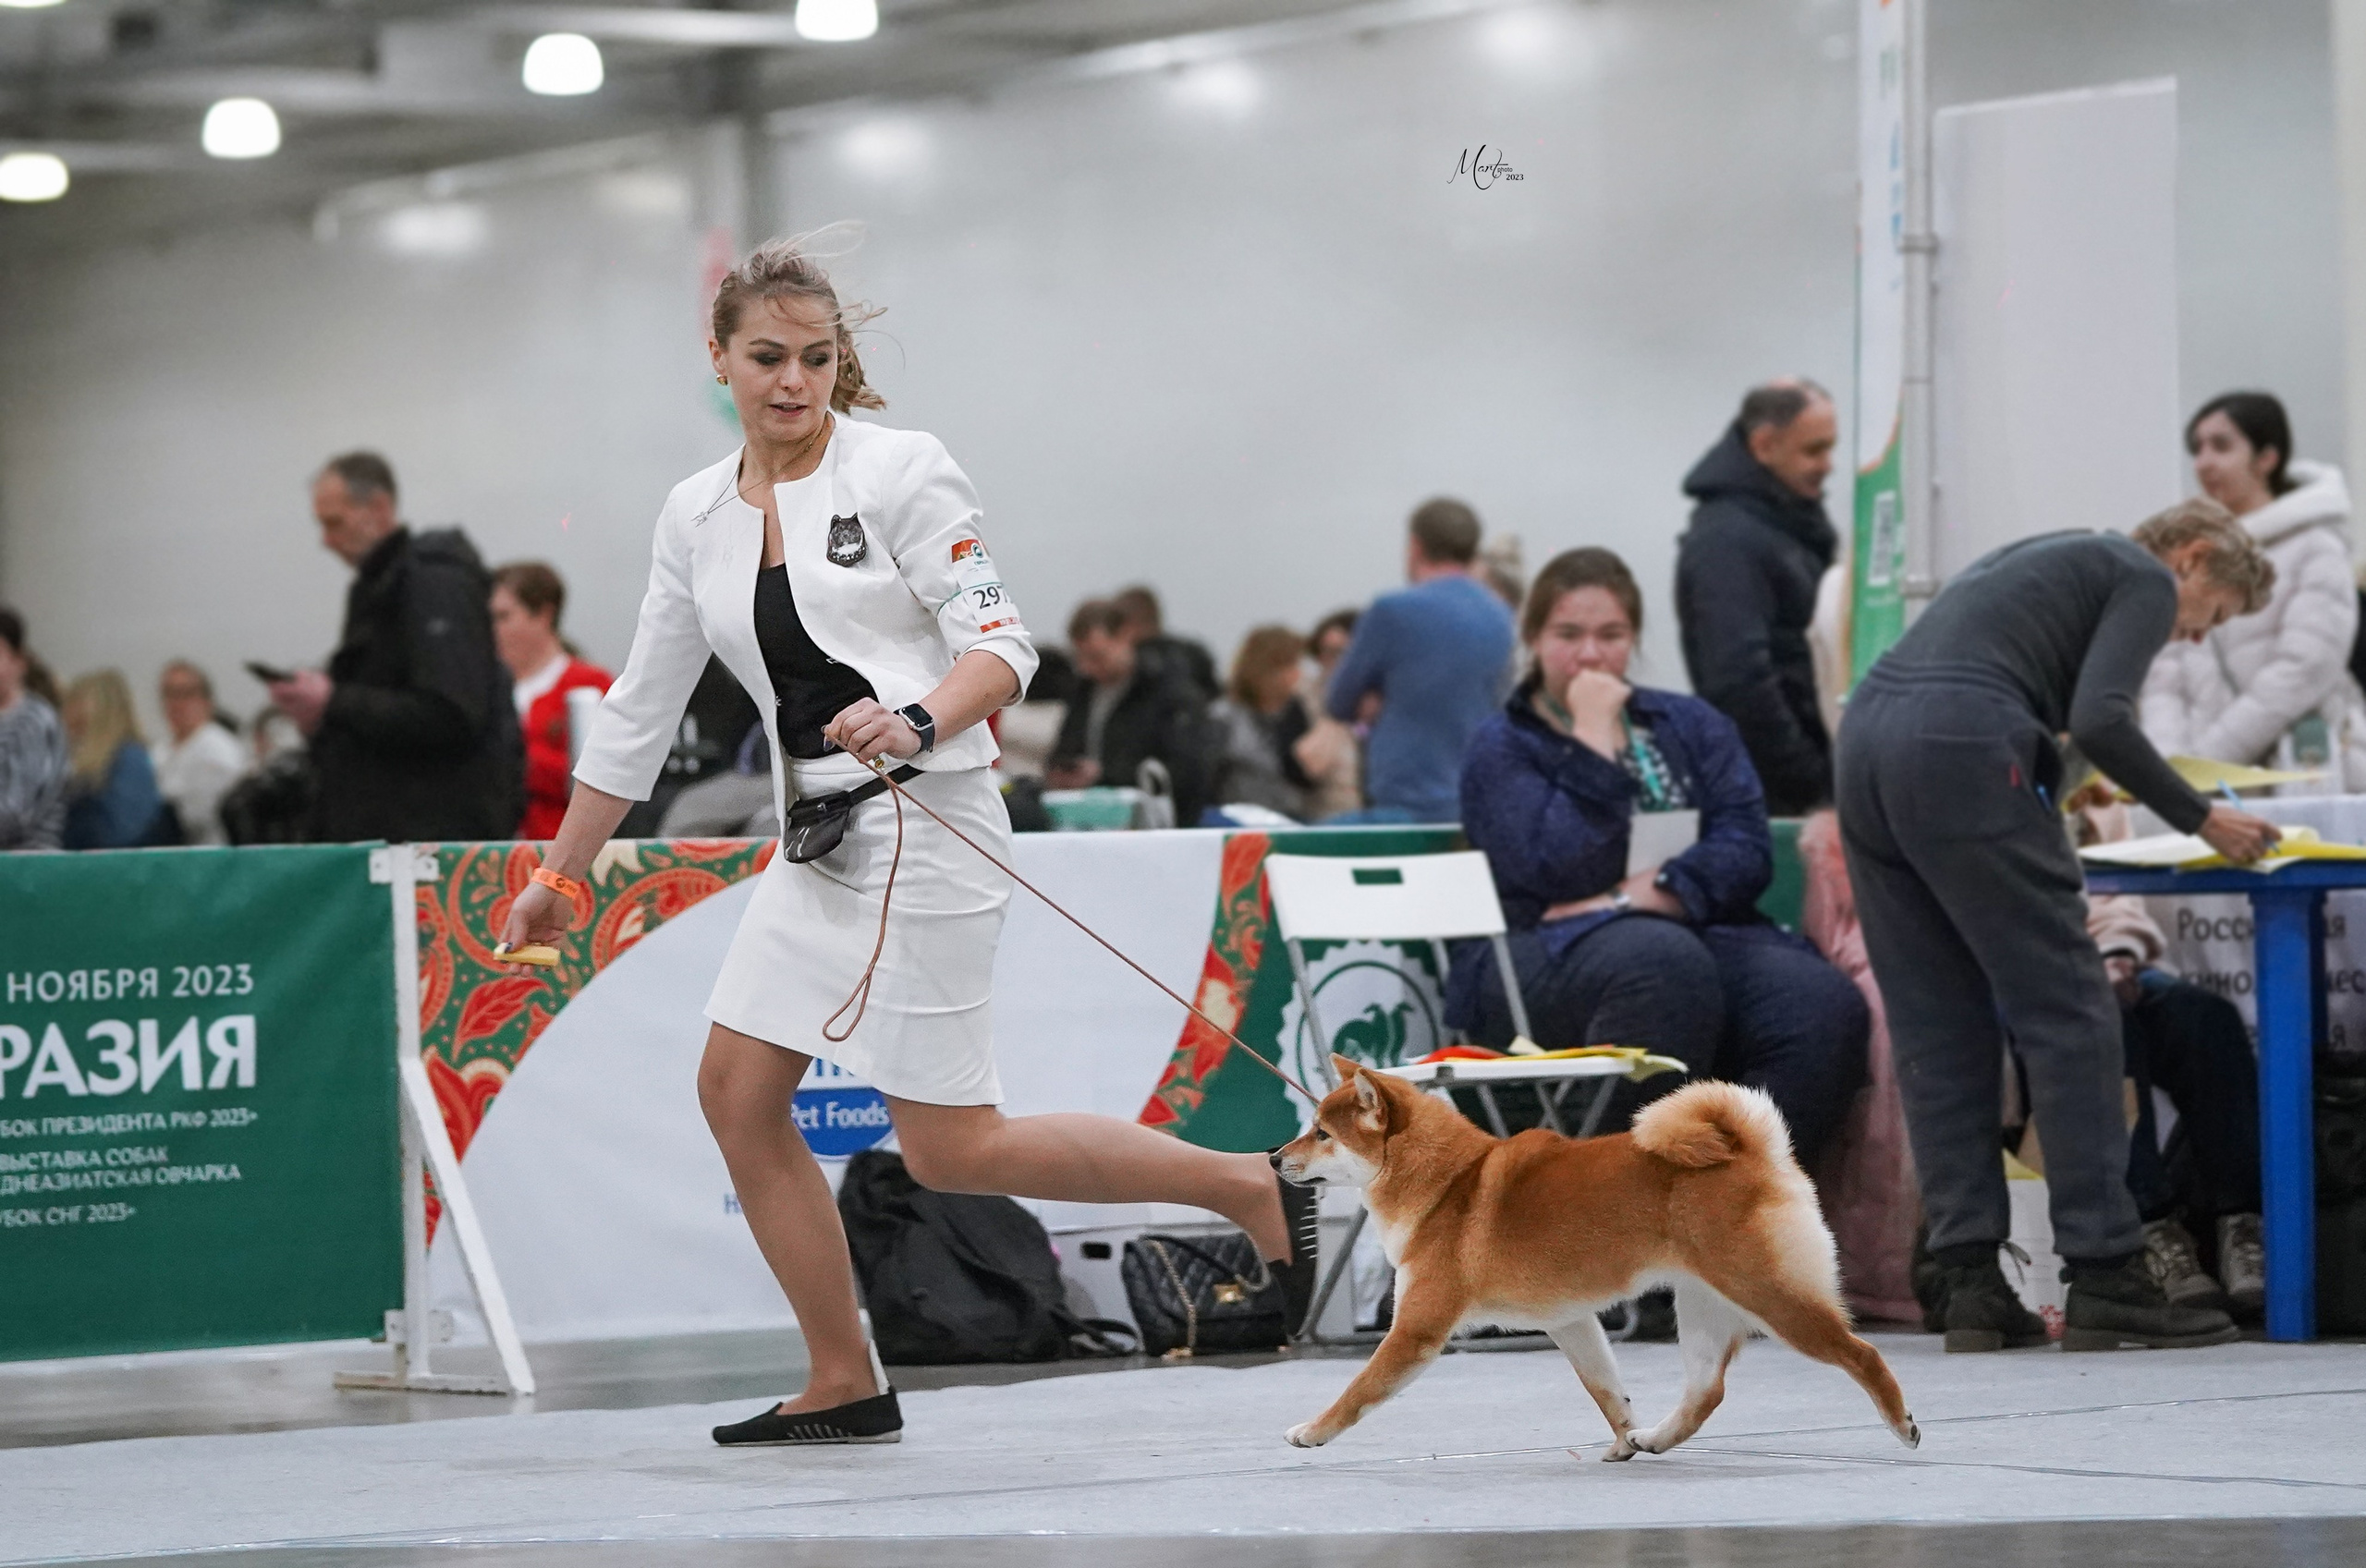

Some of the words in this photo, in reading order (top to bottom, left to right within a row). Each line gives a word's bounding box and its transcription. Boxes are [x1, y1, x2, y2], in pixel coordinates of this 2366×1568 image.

[972, 585, 1006, 610] 29
[6, 967, 159, 1003] НОЯБРЯ
[172, 964, 254, 998] 2023
[0, 1015, 257, 1100] РАЗИЯ
[42, 1112, 167, 1136] ПРЕЗИДЕНТА
[170, 1110, 208, 1128] РКФ
[826, 1100, 890, 1129] Foods
[105, 1146, 169, 1167] СОБАК
[154, 1163, 242, 1185] ОВЧАРКА
[0, 1208, 42, 1228] БОК
[45, 1205, 83, 1226] СНГ
